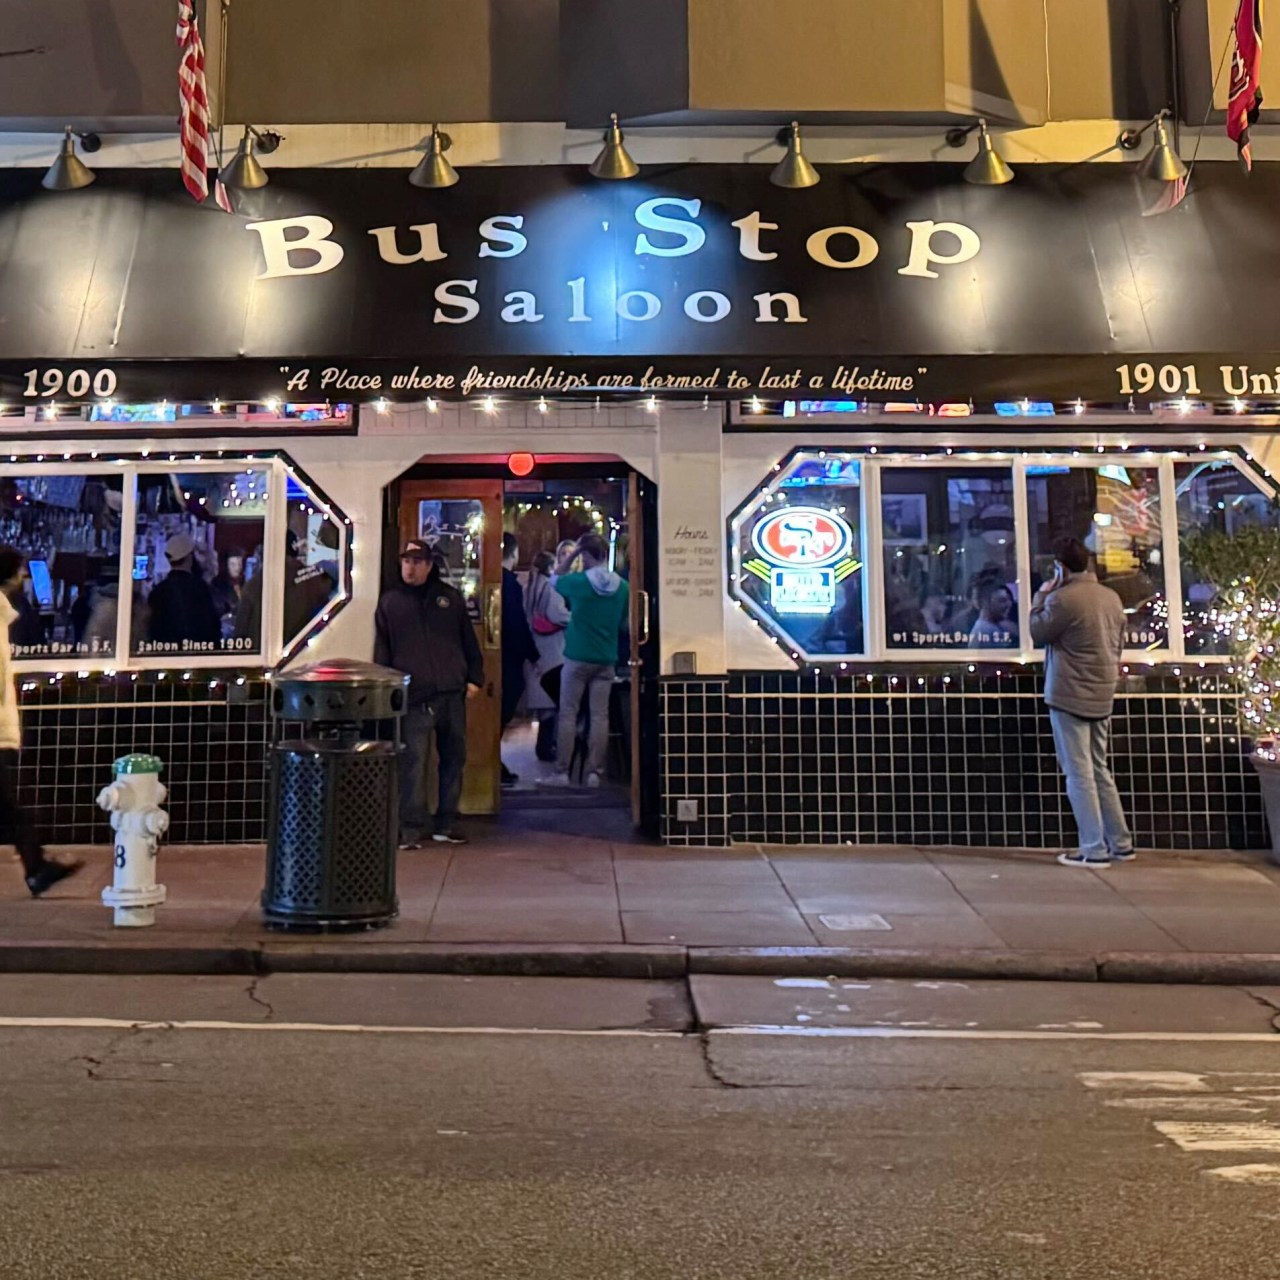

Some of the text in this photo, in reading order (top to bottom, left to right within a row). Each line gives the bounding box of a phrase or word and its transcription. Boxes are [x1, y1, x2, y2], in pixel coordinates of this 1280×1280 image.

[245, 197, 983, 280] Bus Stop
[432, 277, 808, 324] Saloon
[22, 367, 117, 397] 1900
[320, 366, 382, 390] Place
[390, 365, 455, 390] where
[461, 365, 589, 396] friendships
[596, 373, 634, 389] are
[640, 365, 720, 392] formed
[727, 369, 751, 390] to
[759, 365, 802, 389] last
[808, 374, 824, 389] a
[1115, 362, 1201, 395] 1901
[51, 641, 73, 653] Bar
[76, 640, 88, 652] in
[137, 639, 179, 653] Saloon
[182, 638, 215, 652] Since
[219, 636, 253, 651] 1900
[911, 631, 953, 645] Sports
[954, 631, 974, 642] Bar
